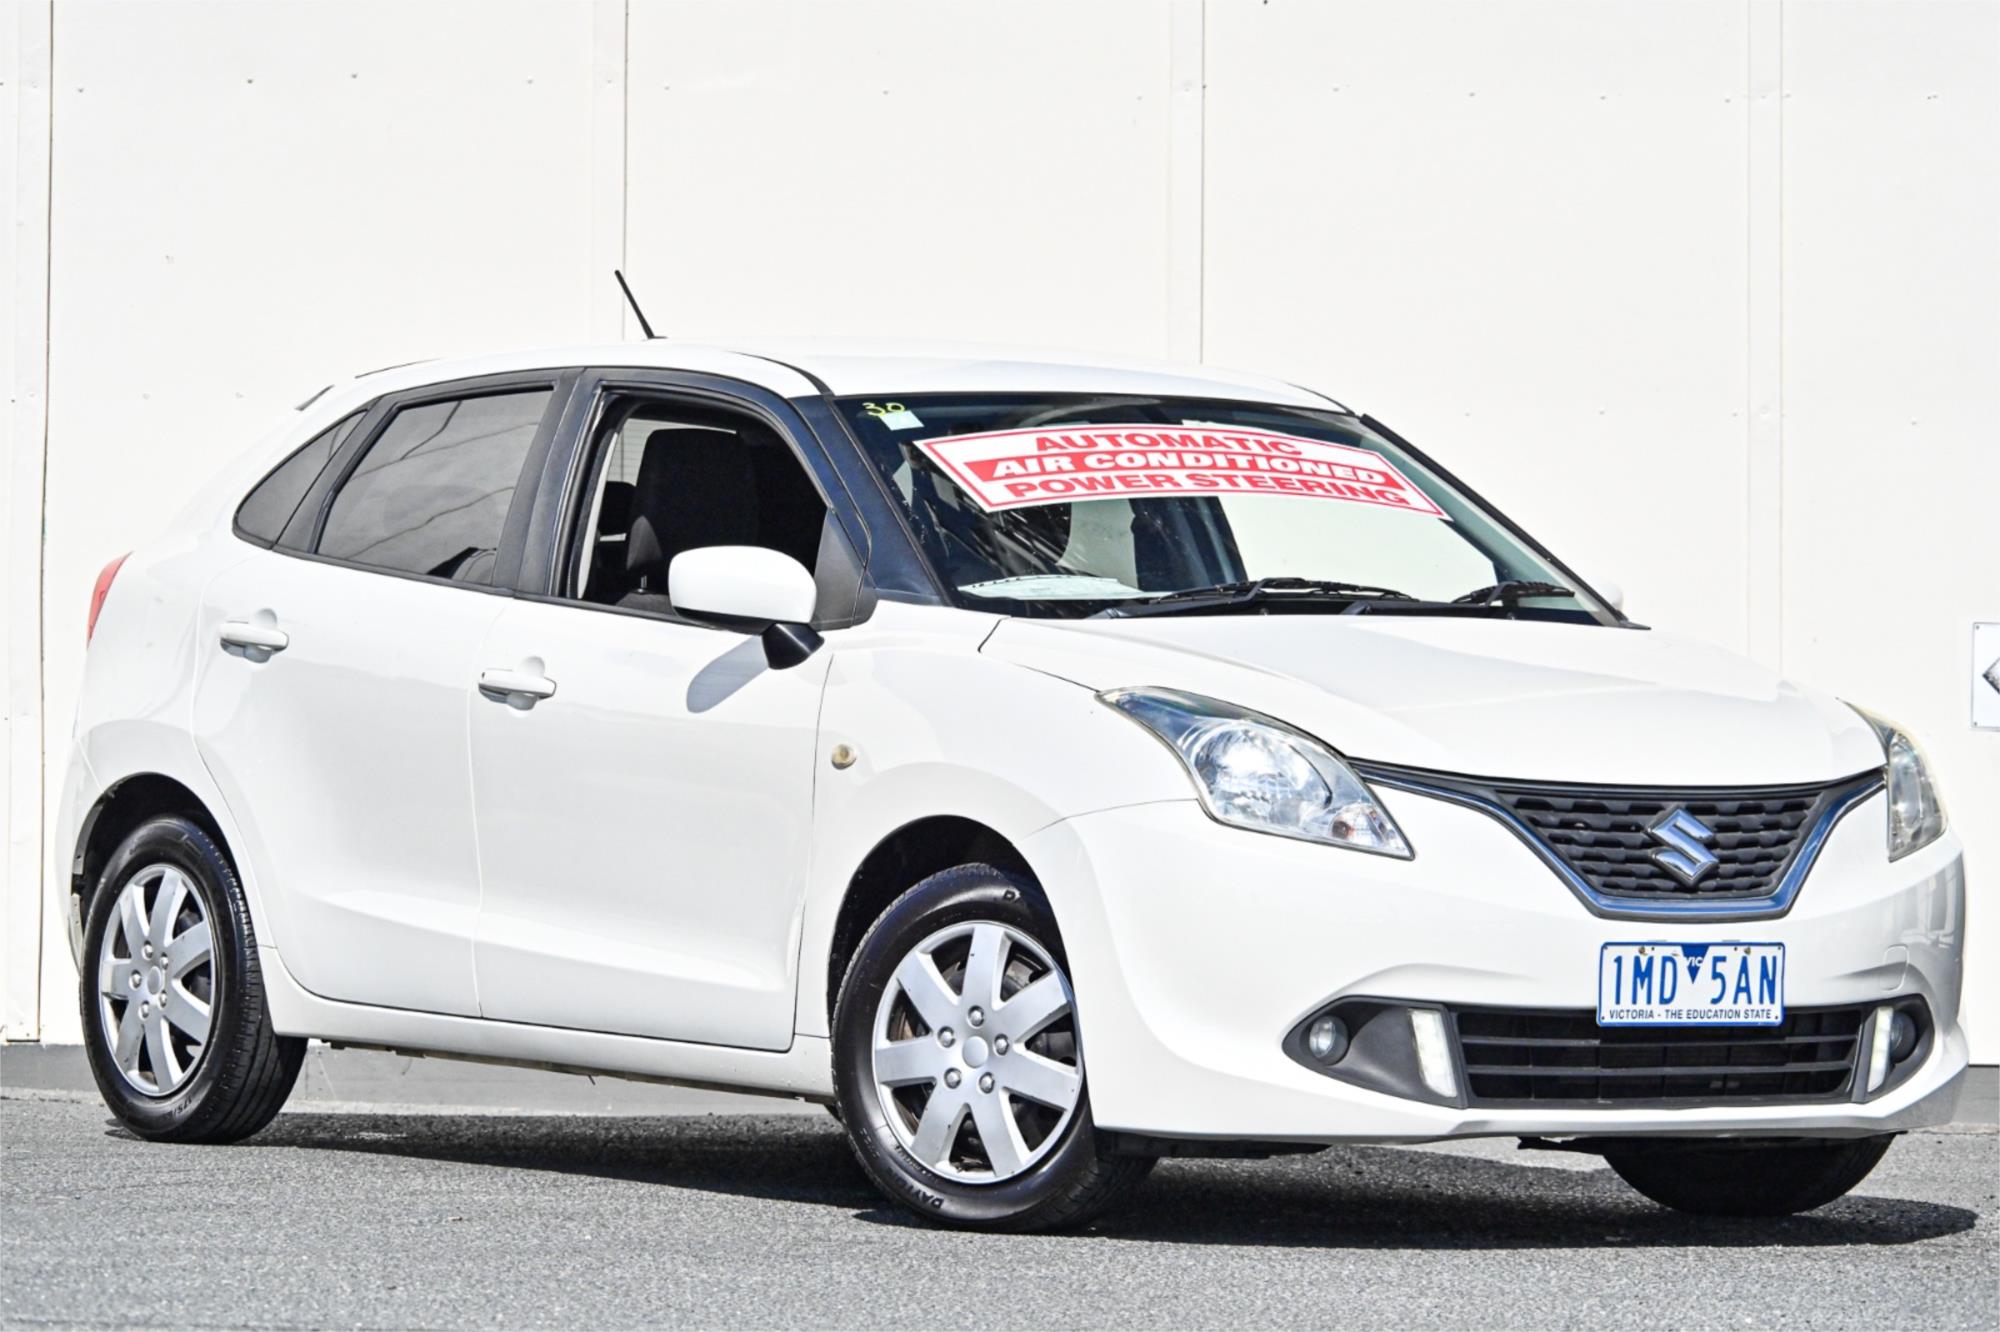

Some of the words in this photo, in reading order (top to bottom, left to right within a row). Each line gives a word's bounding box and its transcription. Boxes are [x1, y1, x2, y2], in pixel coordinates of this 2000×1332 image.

[1035, 433, 1302, 456] AUTOMATIC
[992, 454, 1075, 478] AIR
[1084, 452, 1386, 484] CONDITIONED
[1004, 473, 1182, 498] POWER
[1185, 473, 1411, 506] STEERING
[1613, 955, 1678, 1005] 1MD
[1710, 955, 1777, 1005] 5AN
[1609, 1009, 1654, 1019] VICTORIA
[1665, 1009, 1683, 1019] THE
[1686, 1009, 1741, 1019] EDUCATION
[1743, 1009, 1771, 1019] STATE
